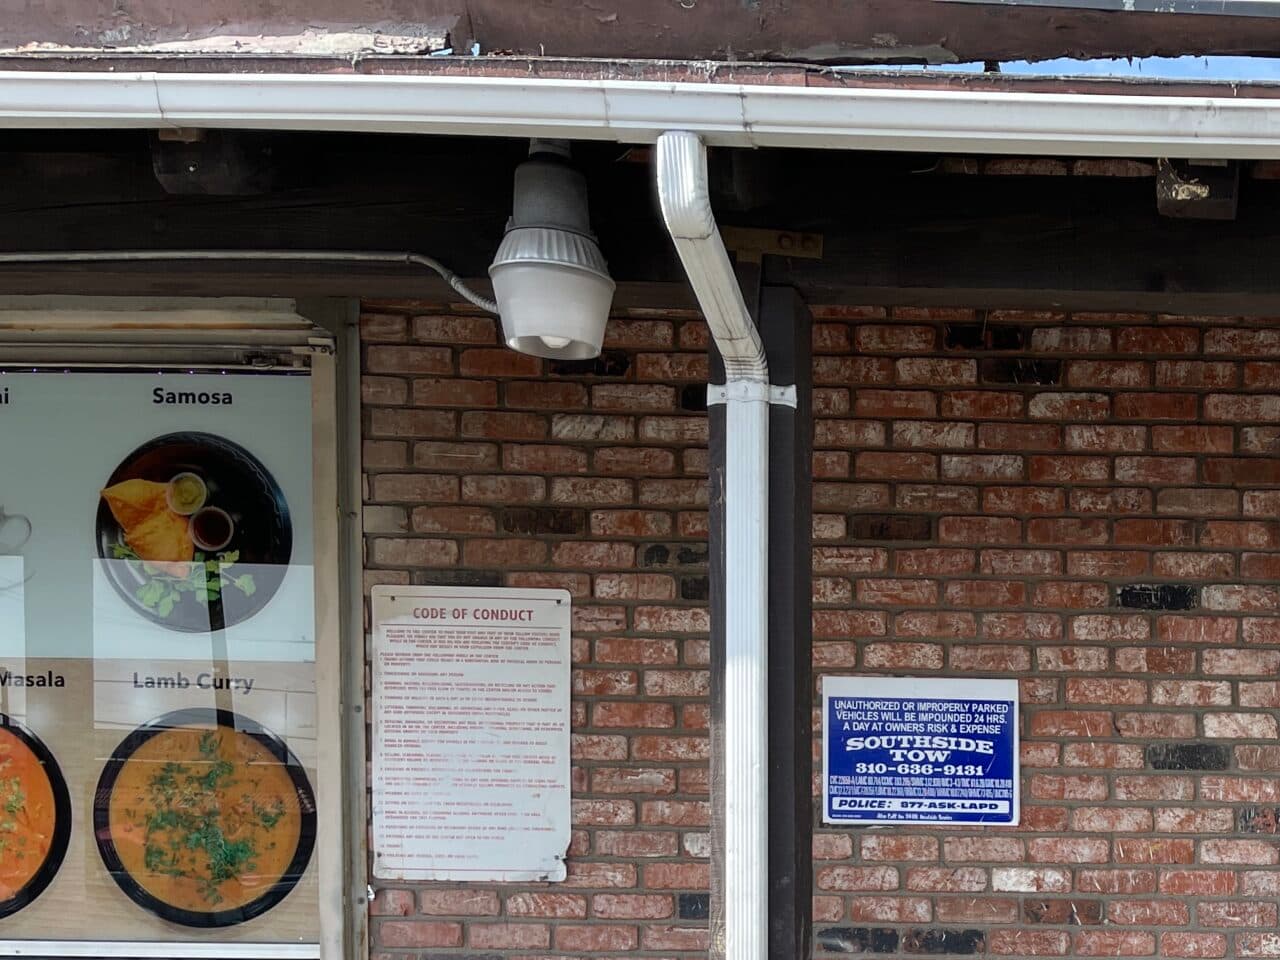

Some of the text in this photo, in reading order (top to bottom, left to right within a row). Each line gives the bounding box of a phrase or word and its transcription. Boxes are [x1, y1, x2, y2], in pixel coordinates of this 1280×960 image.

[152, 387, 233, 405] Samosa
[413, 607, 534, 621] CODE OF CONDUCT
[133, 672, 255, 695] Lamb Curry
[834, 700, 1009, 713] UNAUTHORIZED OR IMPROPERLY PARKED
[836, 710, 1008, 725] VEHICLES WILL BE IMPOUNDED 24 HRS.
[843, 721, 1001, 735] A DAY AT OWNERS RISK & EXPENSE
[846, 735, 993, 755] SOUTHSIDE
[890, 749, 951, 762] TOW
[856, 763, 985, 776] 310-636-9131
[838, 799, 892, 809] POLICE:
